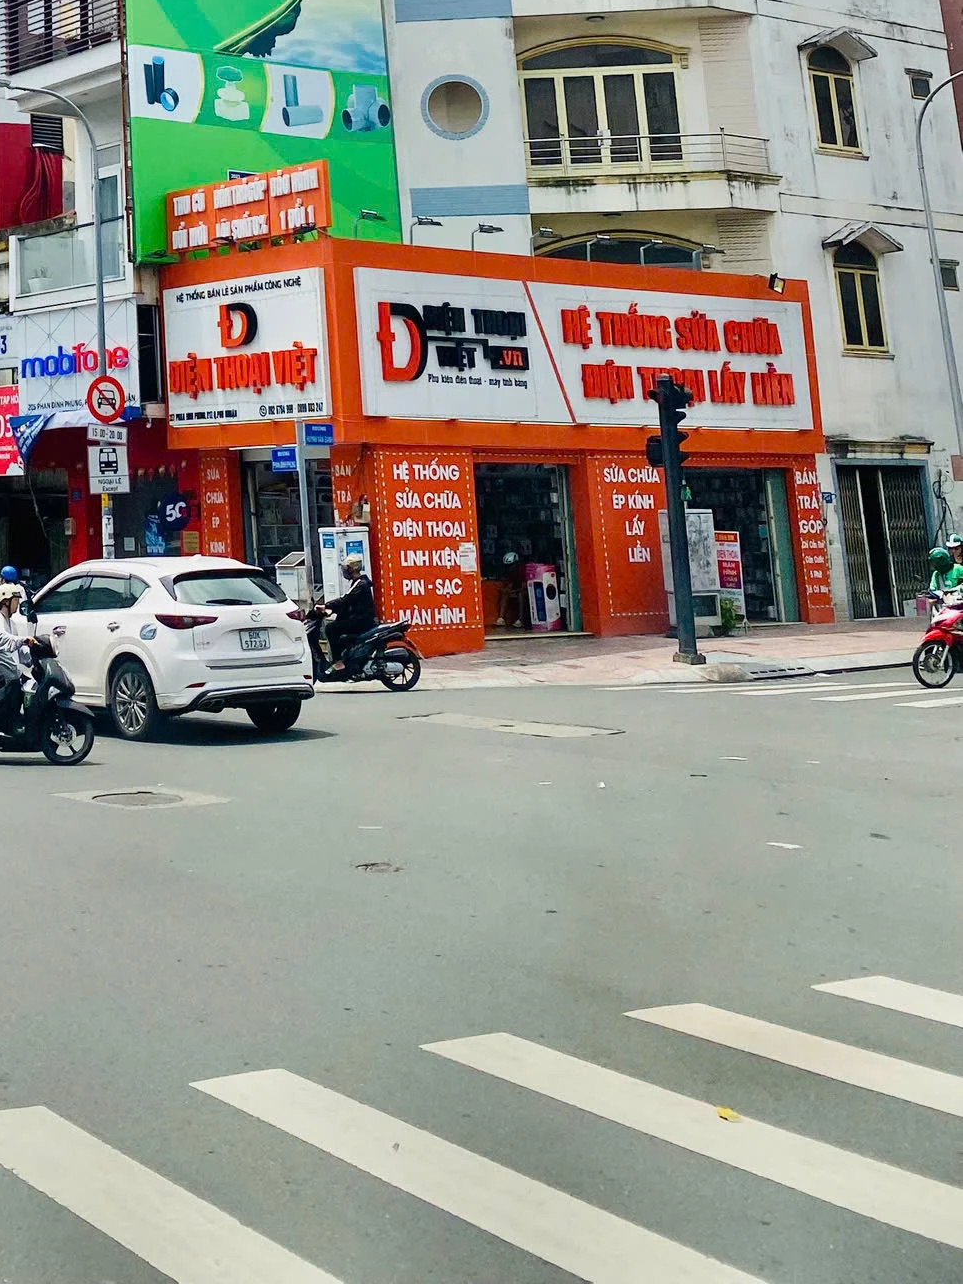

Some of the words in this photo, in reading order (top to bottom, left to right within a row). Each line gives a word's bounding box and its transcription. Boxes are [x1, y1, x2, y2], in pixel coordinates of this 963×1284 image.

[177, 294, 184, 303] HỆ
[186, 289, 205, 300] THỐNG
[207, 287, 221, 298] BÁN
[265, 280, 281, 290] CÔNG
[283, 276, 301, 288] NGHỆ
[561, 304, 593, 349] HỆ
[596, 303, 673, 349] THỐNG
[674, 310, 721, 352] SỬA
[723, 317, 783, 356] CHỮA
[169, 353, 213, 400] ĐIỆN
[214, 352, 271, 394] THOẠI
[272, 342, 317, 391] VIỆT
[581, 359, 635, 404] ĐIỆN
[708, 362, 745, 404] LẤY
[751, 362, 795, 405] LIỀN
[37, 402, 50, 410] PHAN
[393, 460, 409, 483] HỆ
[413, 458, 459, 481] THỐNG
[603, 463, 626, 483] SỬA
[628, 466, 661, 484] CHỮA
[795, 467, 817, 485] BÁN
[396, 487, 421, 508] SỬA
[423, 490, 461, 508] CHỮA
[613, 489, 625, 508] ÉP
[628, 490, 655, 509] KÍNH
[799, 491, 819, 509] TRẢ
[211, 512, 219, 528] ÉP
[393, 518, 423, 540] ĐIỆN
[426, 521, 466, 540] THOẠI
[625, 514, 645, 536] LẤY
[800, 515, 823, 534] GÓP
[401, 550, 429, 566] LINH
[433, 547, 461, 570] KIỆN
[629, 540, 651, 562] LIỀN
[403, 580, 425, 596] PIN
[436, 578, 463, 598] SẠC
[399, 605, 431, 625] MÀN
[435, 604, 466, 624] HÌNH
